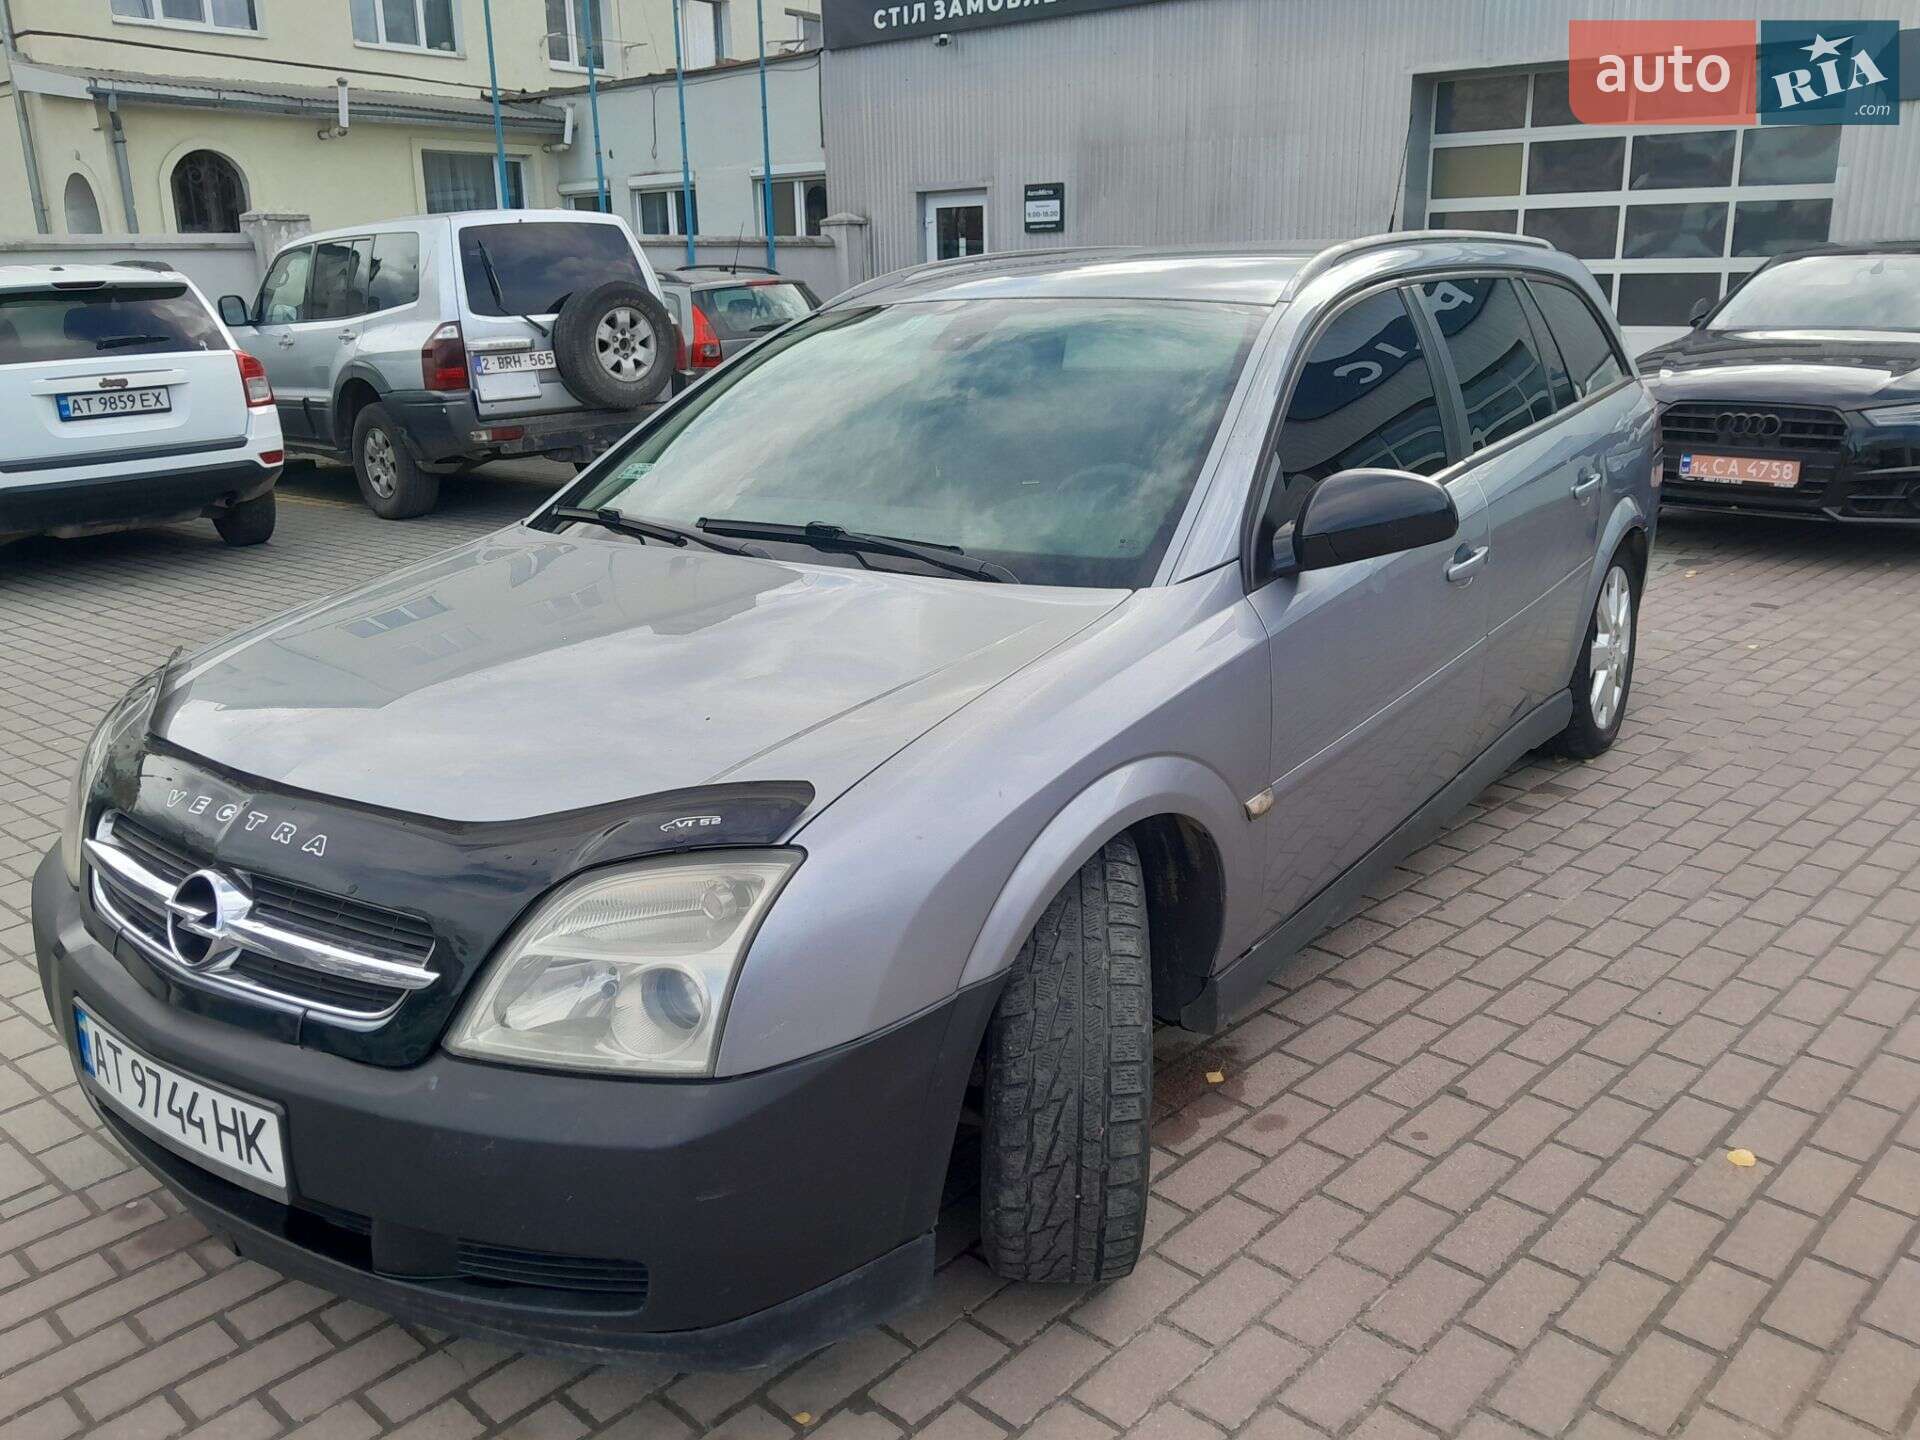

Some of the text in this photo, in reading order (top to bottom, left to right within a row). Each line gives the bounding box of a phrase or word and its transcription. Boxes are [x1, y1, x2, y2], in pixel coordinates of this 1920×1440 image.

[873, 2, 926, 30] СТІЛ
[72, 392, 164, 414] AT 9859 EX
[1713, 458, 1739, 475] CA
[1747, 461, 1793, 480] 4758
[166, 789, 328, 857] VECTRA
[94, 1030, 273, 1174] AT 9744 HK
